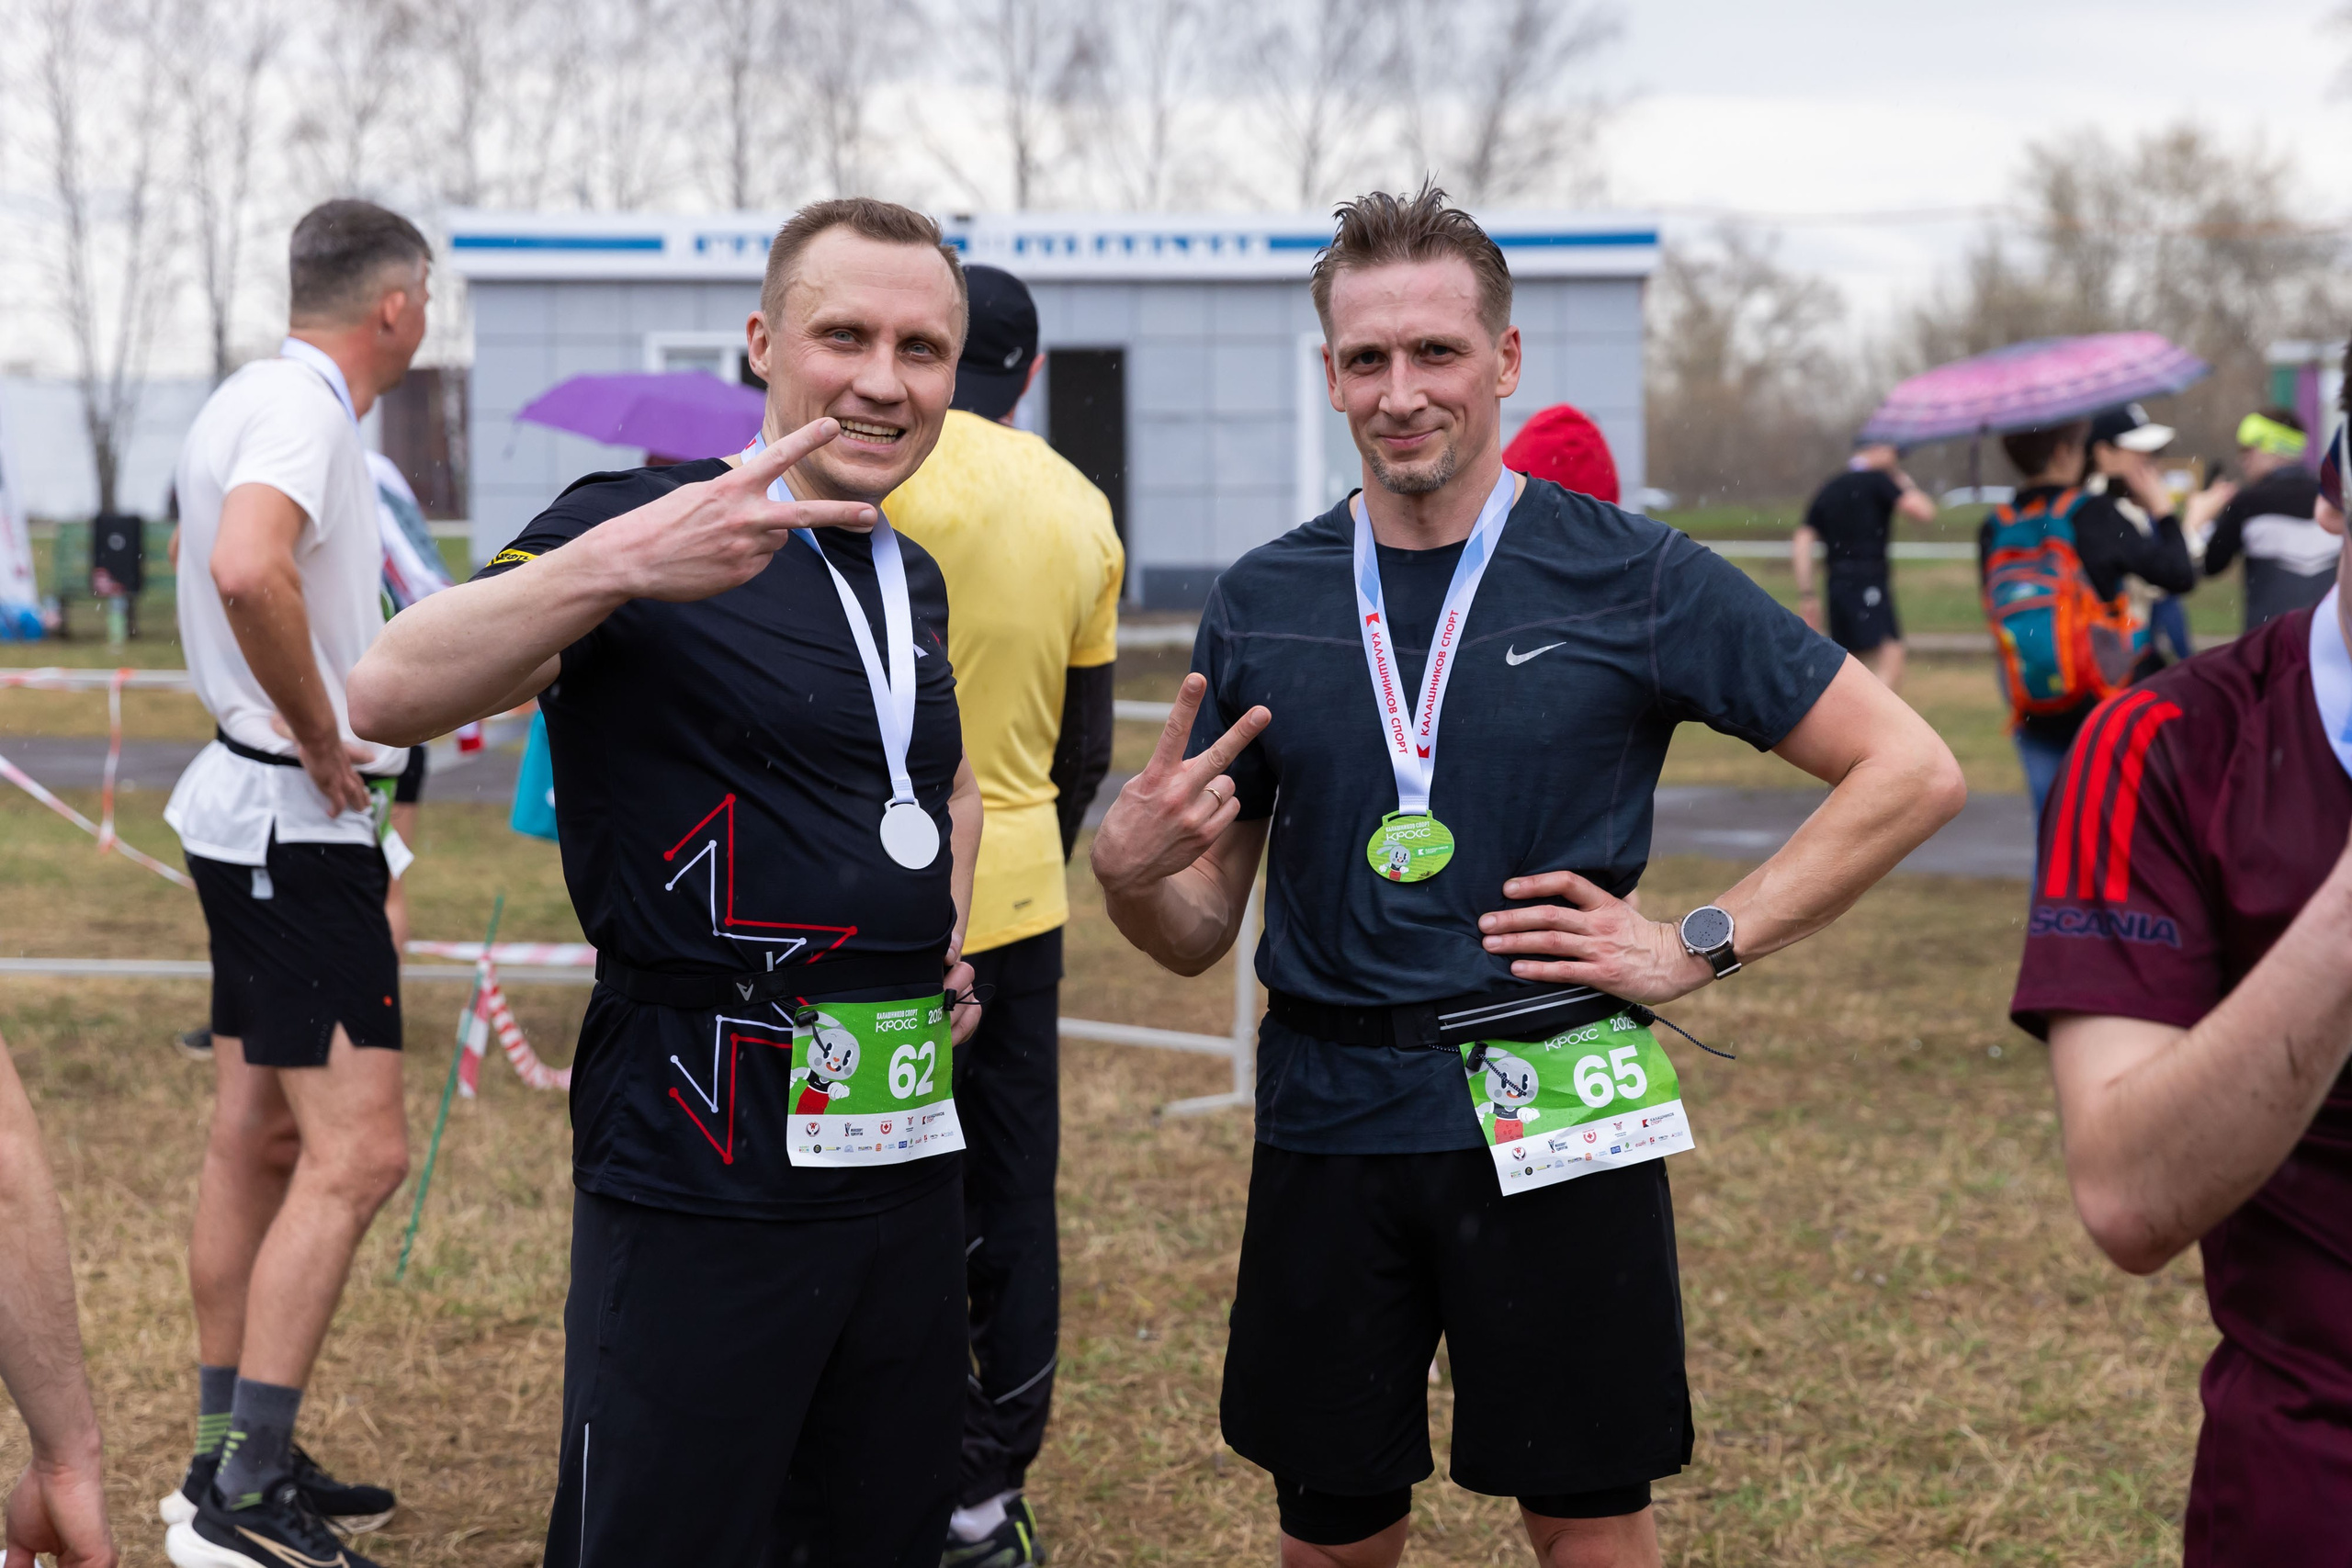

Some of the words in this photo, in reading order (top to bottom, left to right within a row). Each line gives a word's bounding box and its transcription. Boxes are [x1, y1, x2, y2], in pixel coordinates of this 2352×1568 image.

[1372, 632, 1397, 714] КАЛАШНИКОВ
[1391, 717, 1408, 754] СПОРТ
[1420, 650, 1447, 736] КАЛАШНИКОВ
[1442, 610, 1459, 648] СПОРТ
[1385, 828, 1431, 840] КРОСС
[2030, 906, 2182, 949] SCANIA
[876, 1018, 918, 1032] КРОСС
[1544, 1028, 1599, 1051] КРОСС
[1610, 1016, 1637, 1032] 2025
[888, 1041, 935, 1100] 62
[1573, 1044, 1647, 1109] 65
